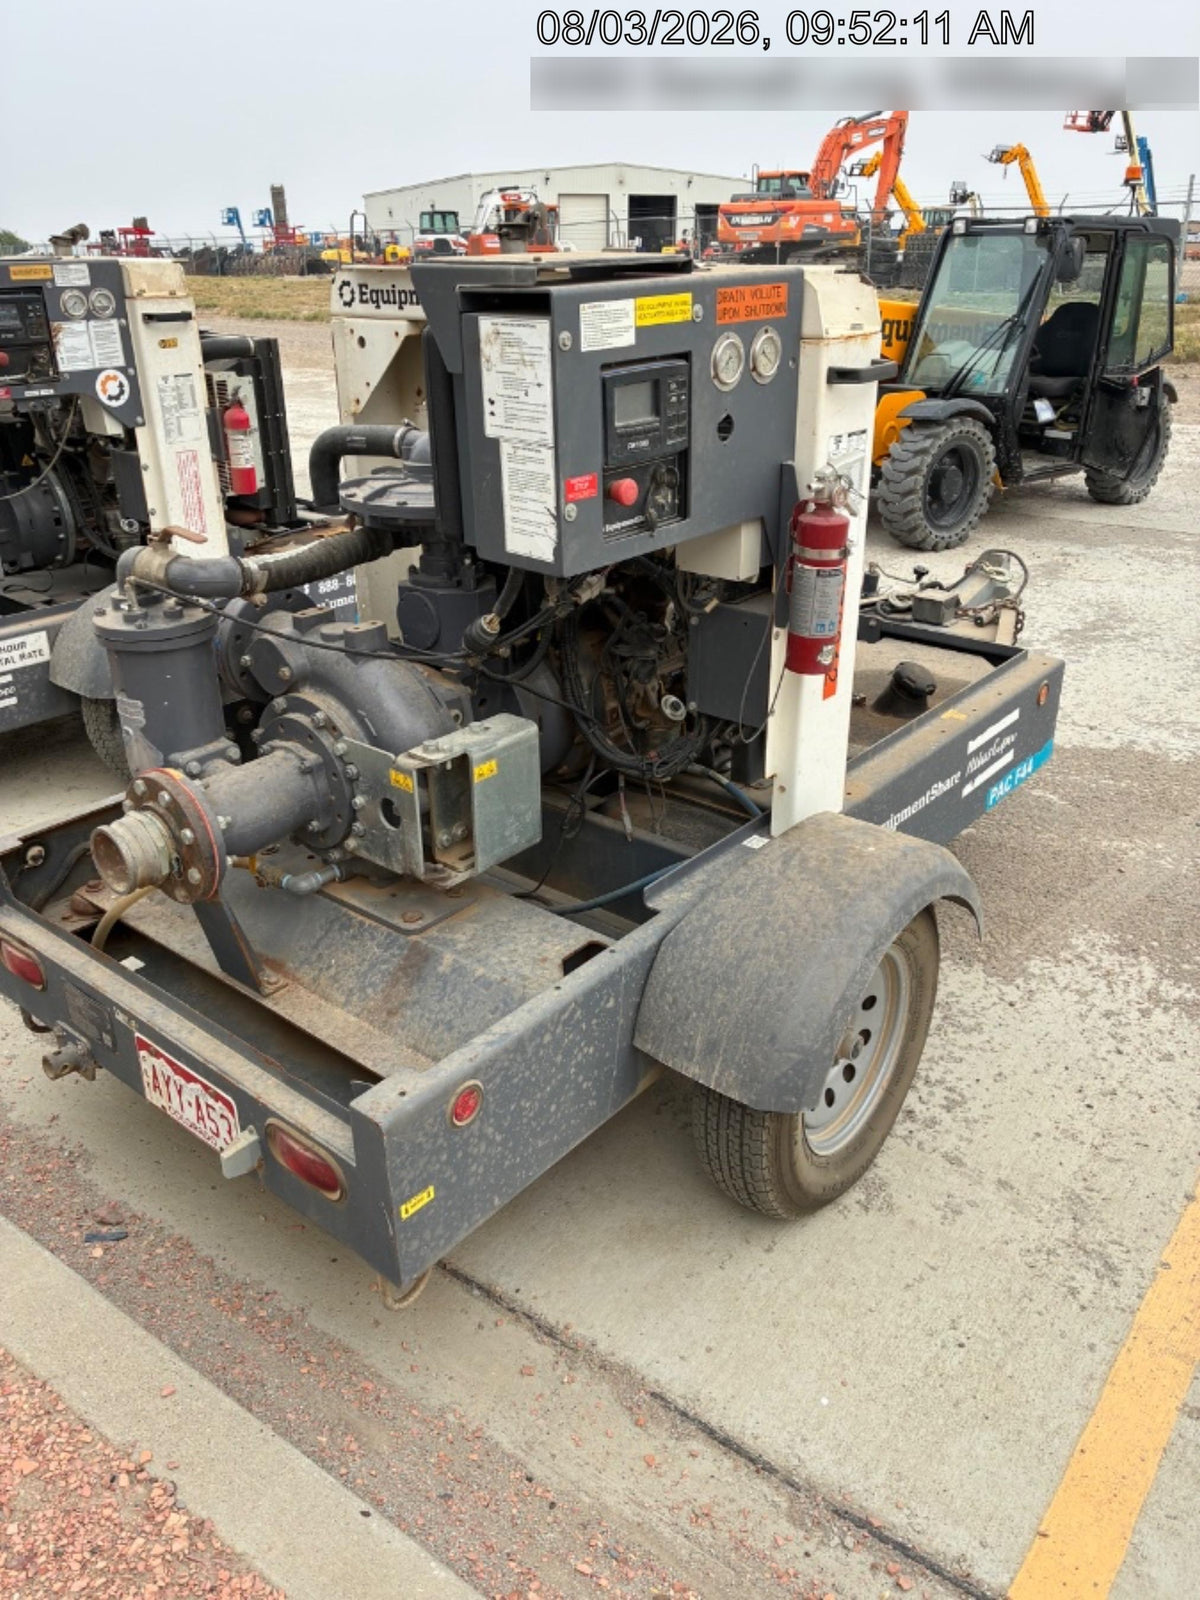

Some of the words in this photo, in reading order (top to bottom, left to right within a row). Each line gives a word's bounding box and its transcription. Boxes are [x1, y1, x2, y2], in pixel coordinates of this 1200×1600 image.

[717, 292, 746, 305] DRAIN
[750, 286, 782, 301] VOLUTE
[717, 306, 740, 321] UPON
[745, 301, 787, 317] SHUTDOWN
[318, 574, 357, 594] 888-8
[989, 774, 1013, 806] PAC
[881, 771, 962, 833] uipmentShare
